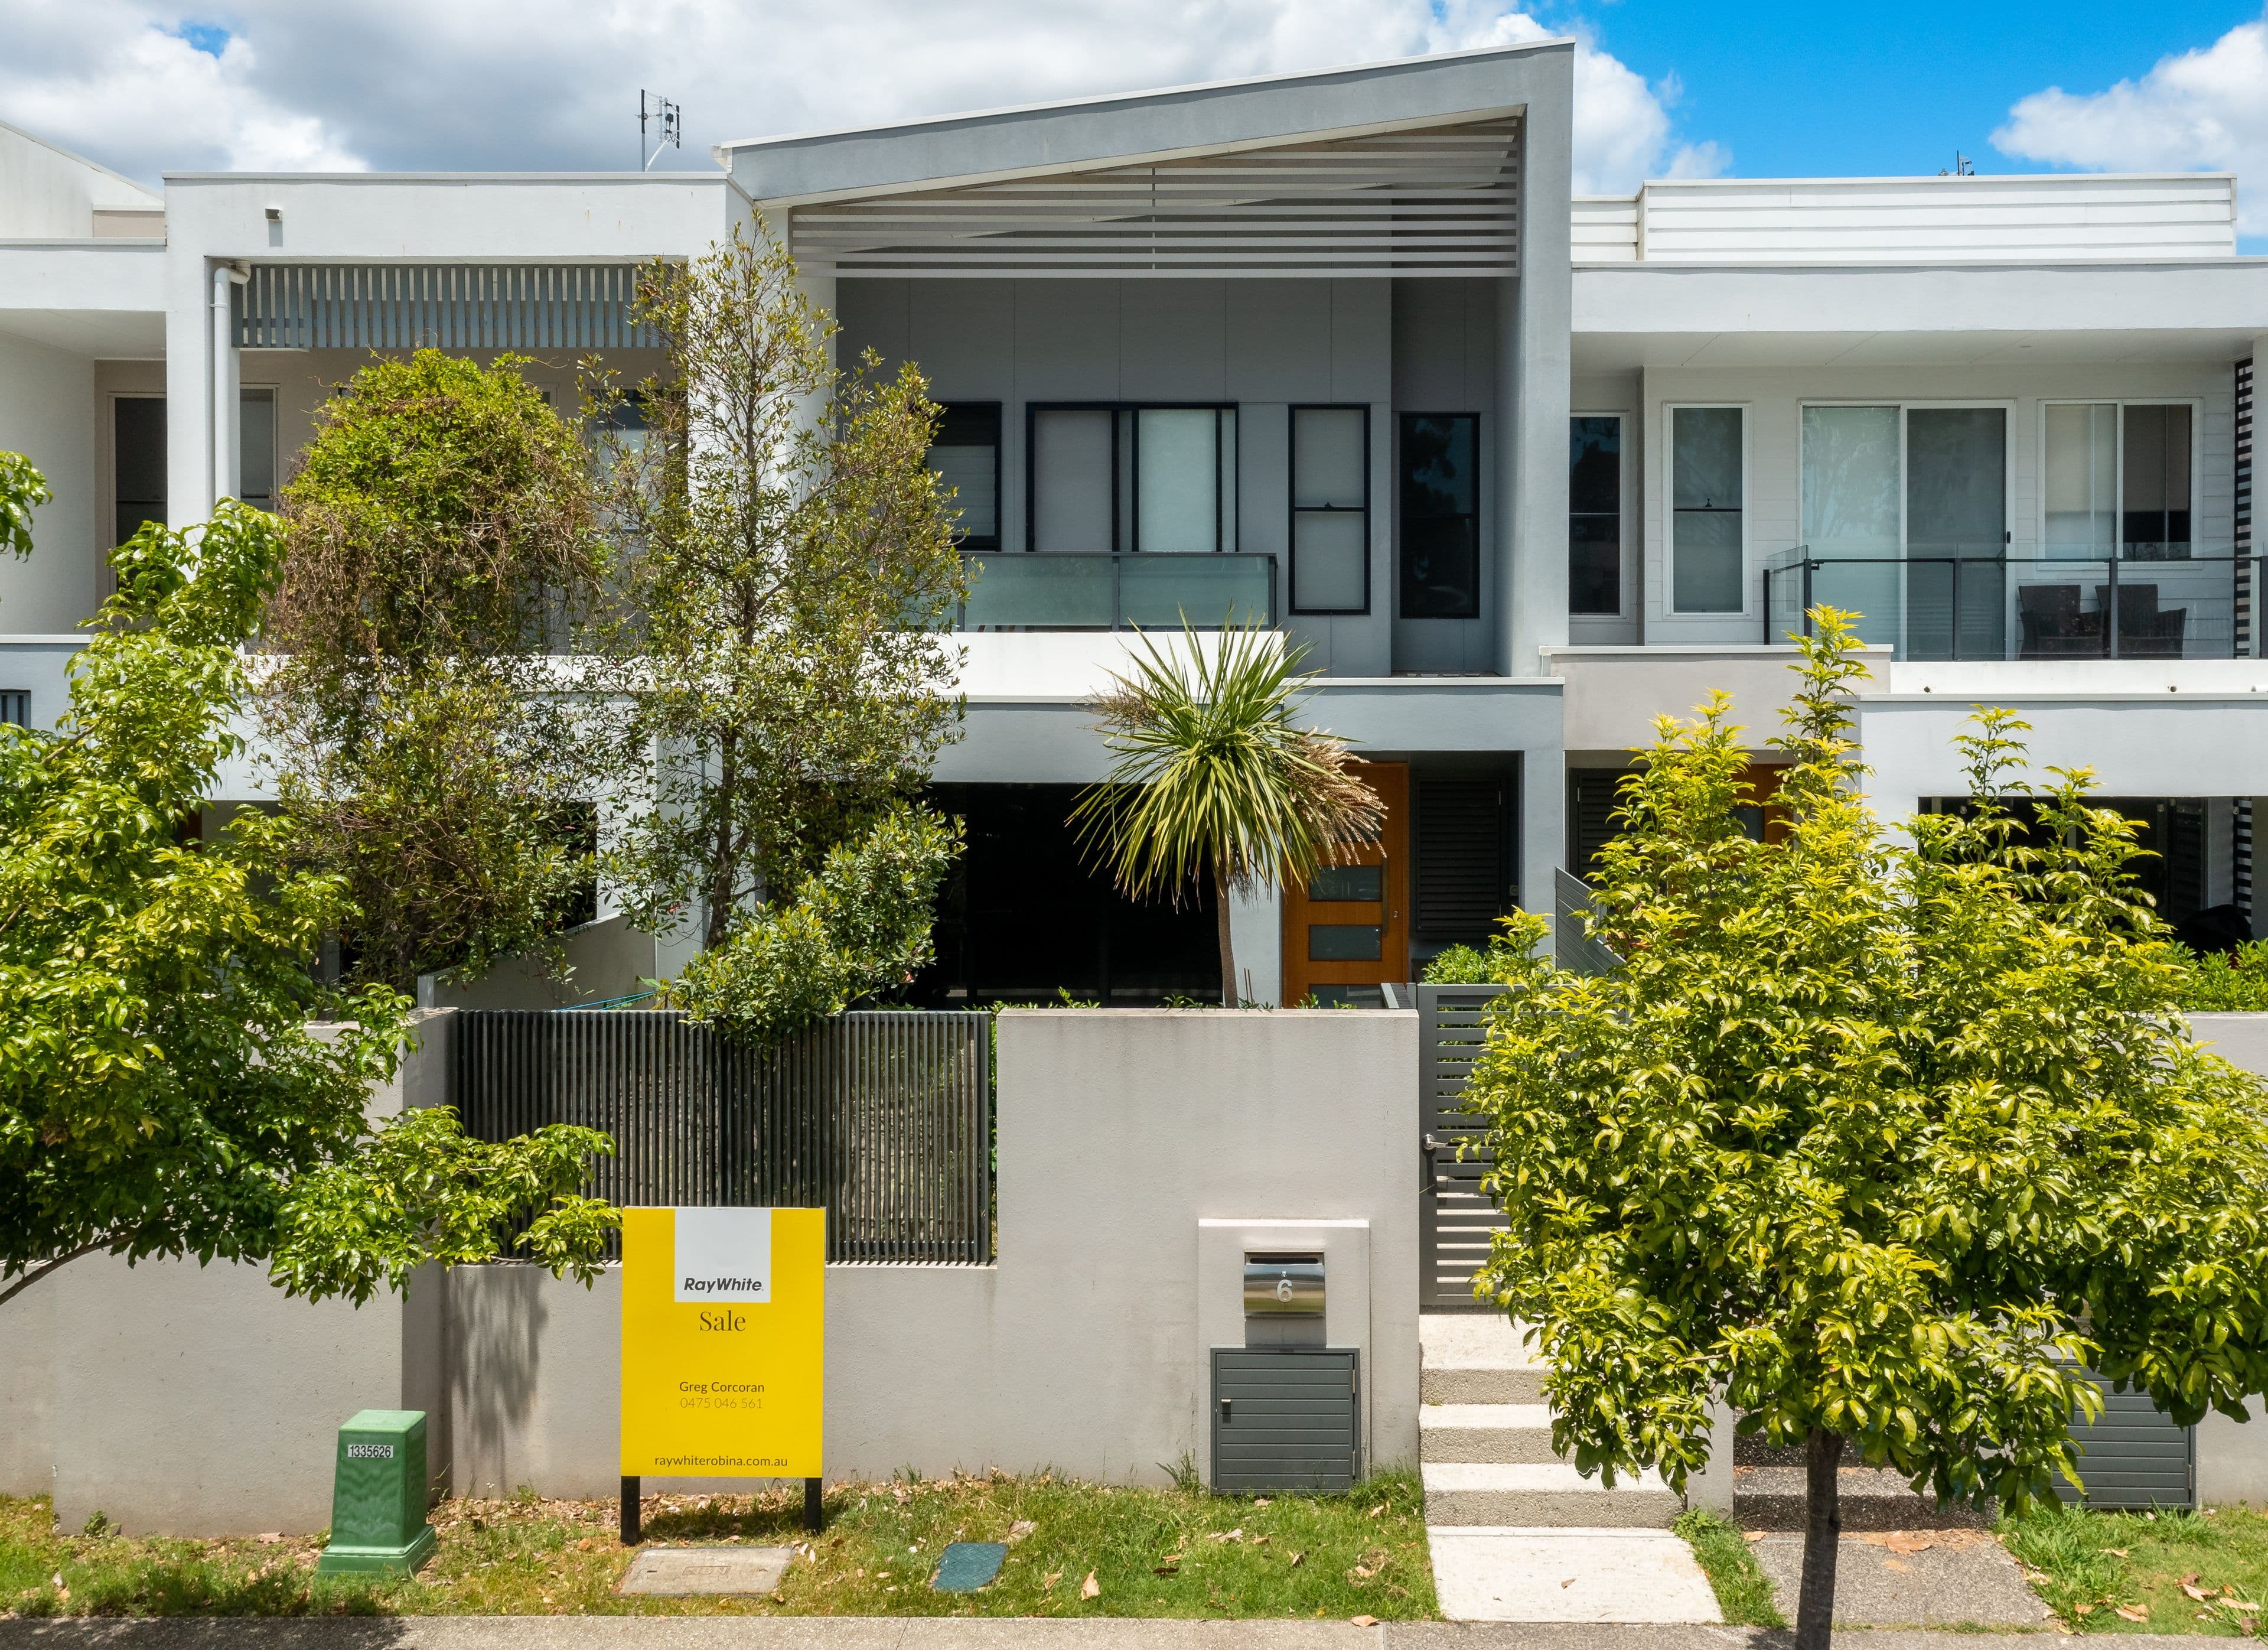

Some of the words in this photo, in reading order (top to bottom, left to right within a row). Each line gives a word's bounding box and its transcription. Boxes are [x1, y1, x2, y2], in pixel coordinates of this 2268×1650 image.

[684, 1277, 762, 1293] RayWhite
[1277, 1279, 1292, 1303] 6
[699, 1310, 746, 1332] Sale
[679, 1381, 708, 1394] Greg
[711, 1382, 764, 1392] Corcoran
[680, 1397, 711, 1408] 0475
[714, 1398, 737, 1408] 046
[741, 1398, 763, 1409] 561
[350, 1445, 391, 1457] 1335626
[654, 1455, 788, 1467] raywhiterobina.com.au
